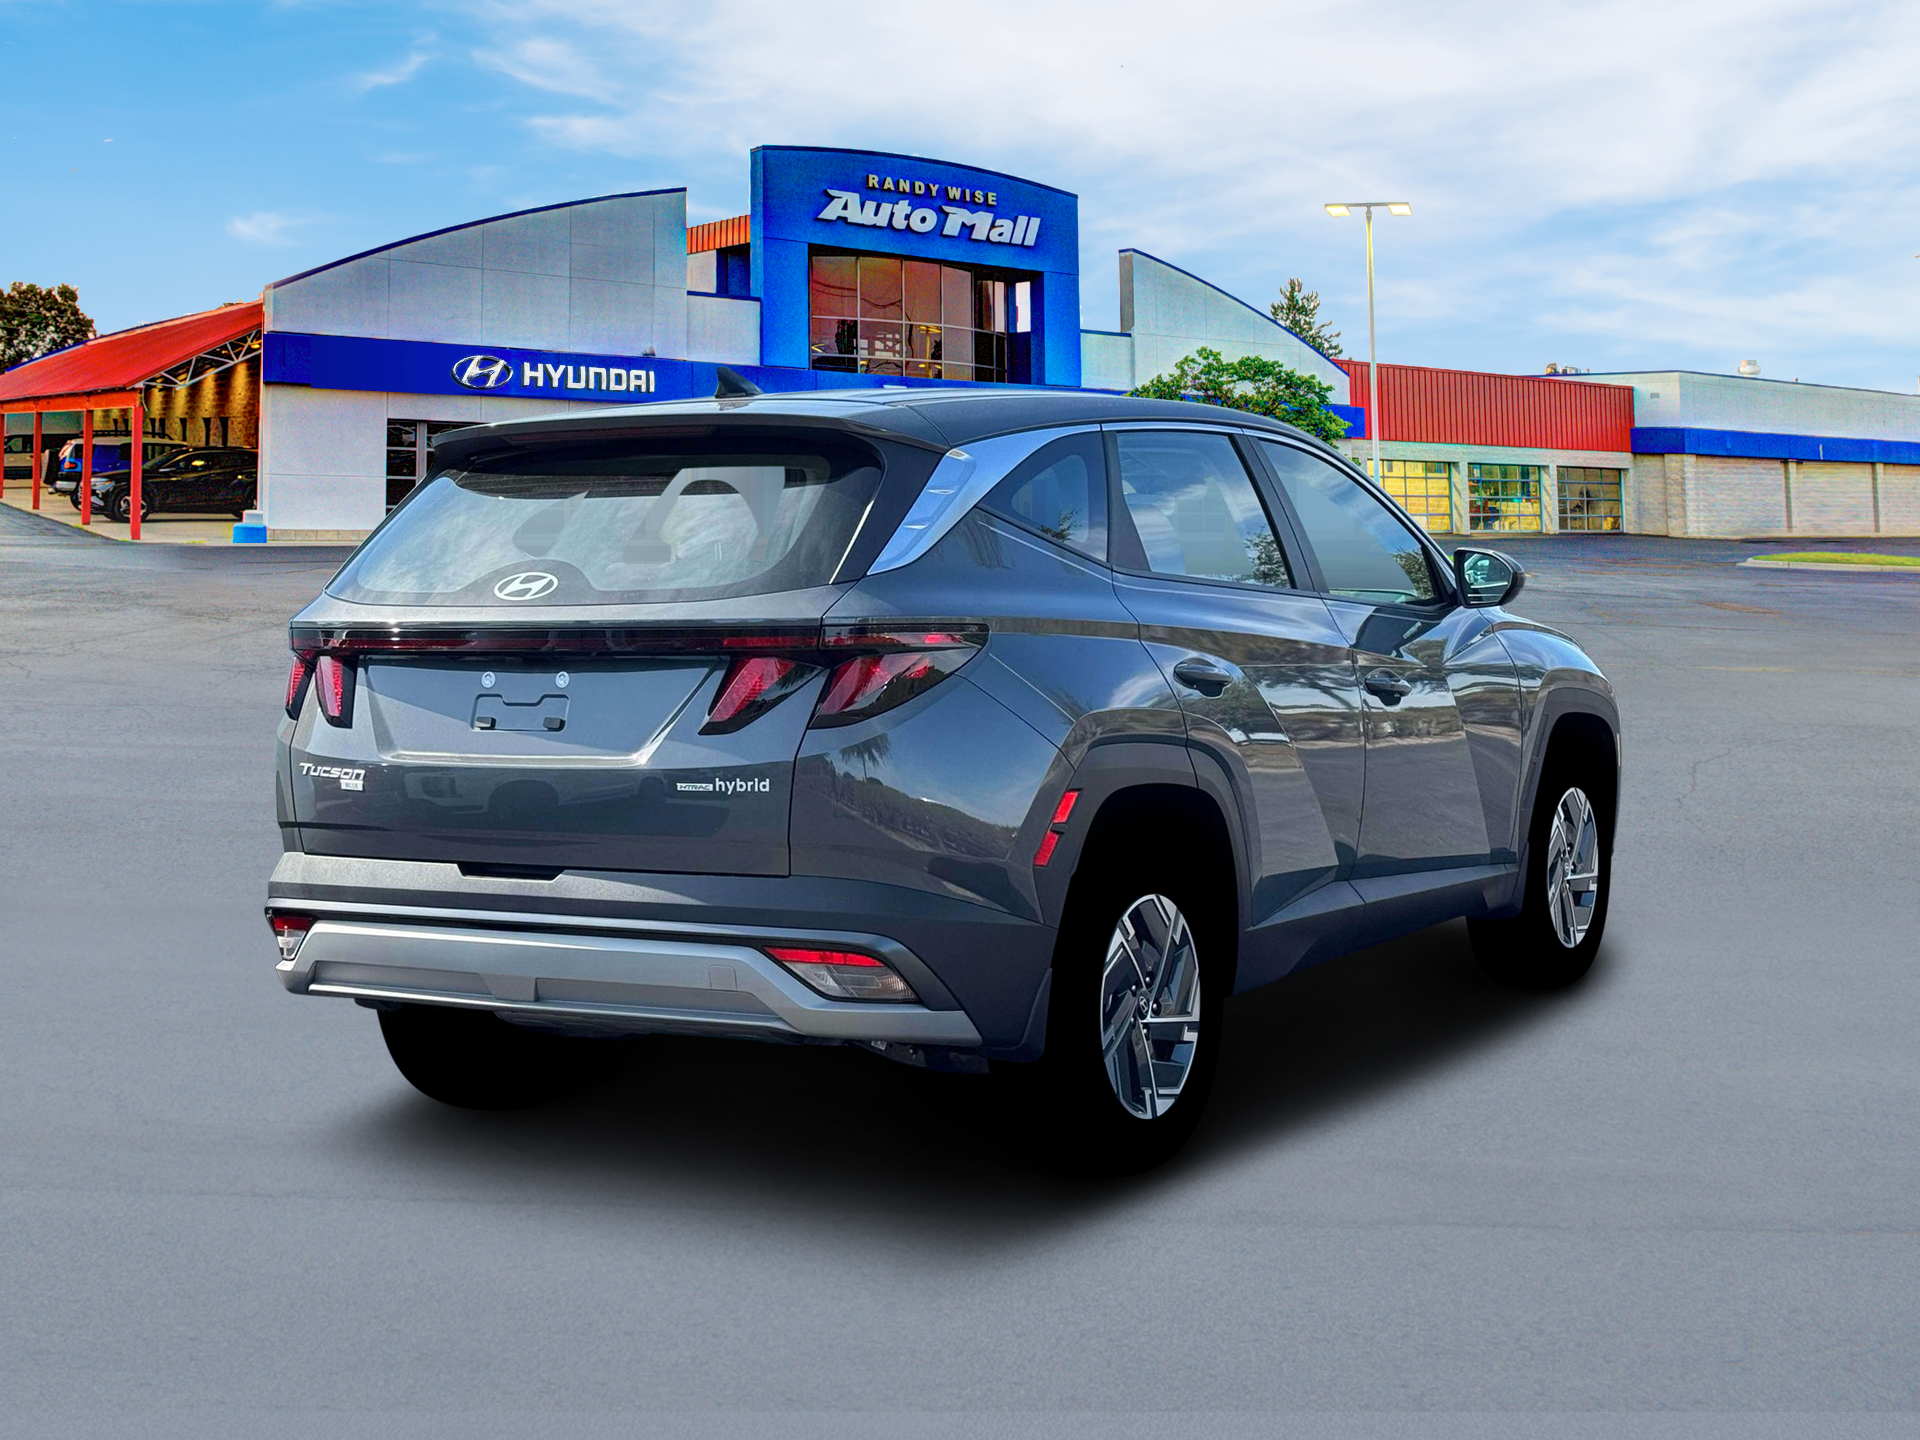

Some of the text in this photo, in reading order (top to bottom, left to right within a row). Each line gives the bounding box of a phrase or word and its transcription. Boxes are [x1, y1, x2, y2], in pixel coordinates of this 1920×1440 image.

[867, 174, 997, 206] RANDY WISE
[816, 189, 1041, 247] Auto Mall
[523, 362, 655, 393] HYUNDAI
[715, 778, 770, 795] hybrid
